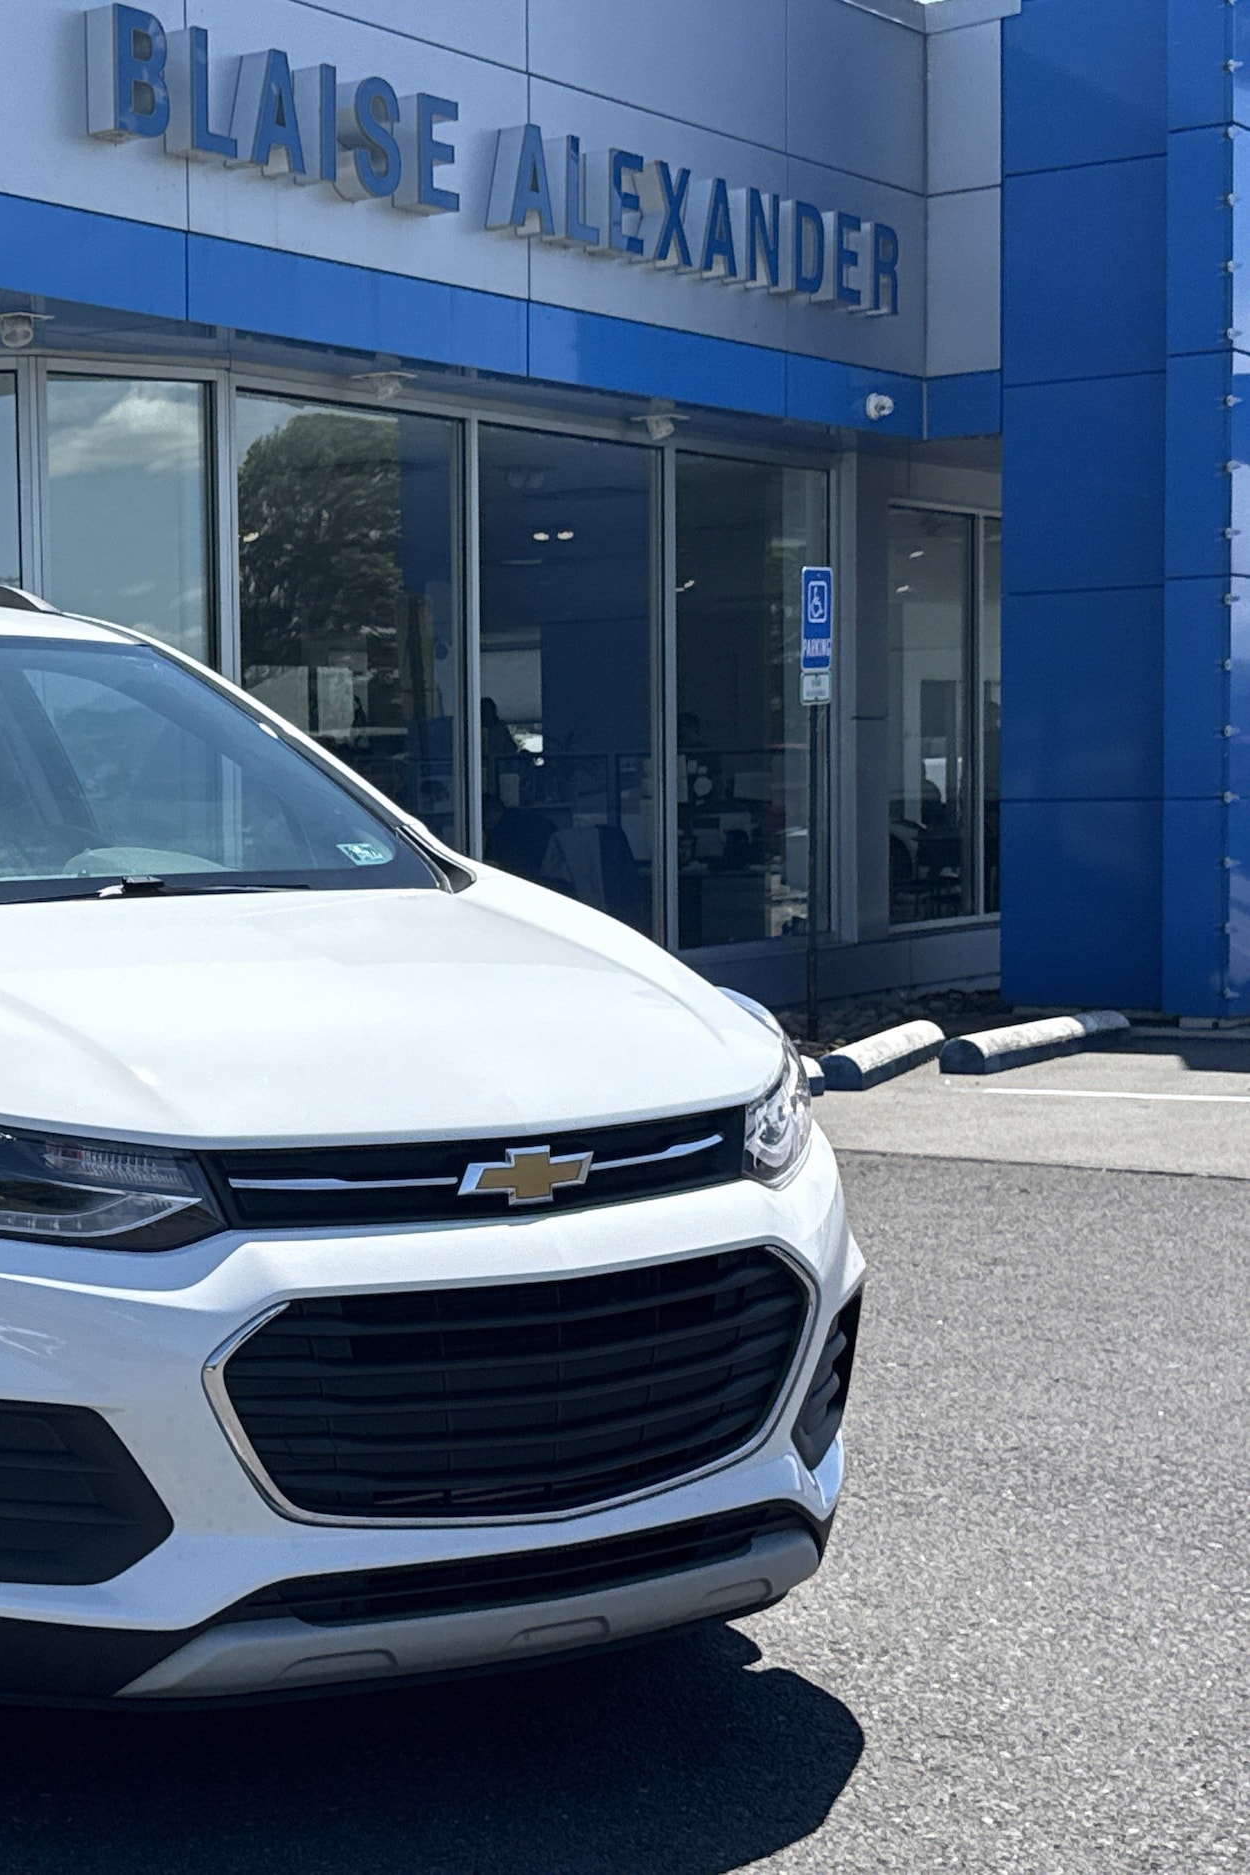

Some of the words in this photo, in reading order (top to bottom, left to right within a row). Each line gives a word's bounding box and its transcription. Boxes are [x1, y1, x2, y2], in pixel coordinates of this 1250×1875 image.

[110, 3, 459, 214] BLAISE
[512, 123, 900, 316] ALEXANDER
[803, 638, 831, 657] PARKING
